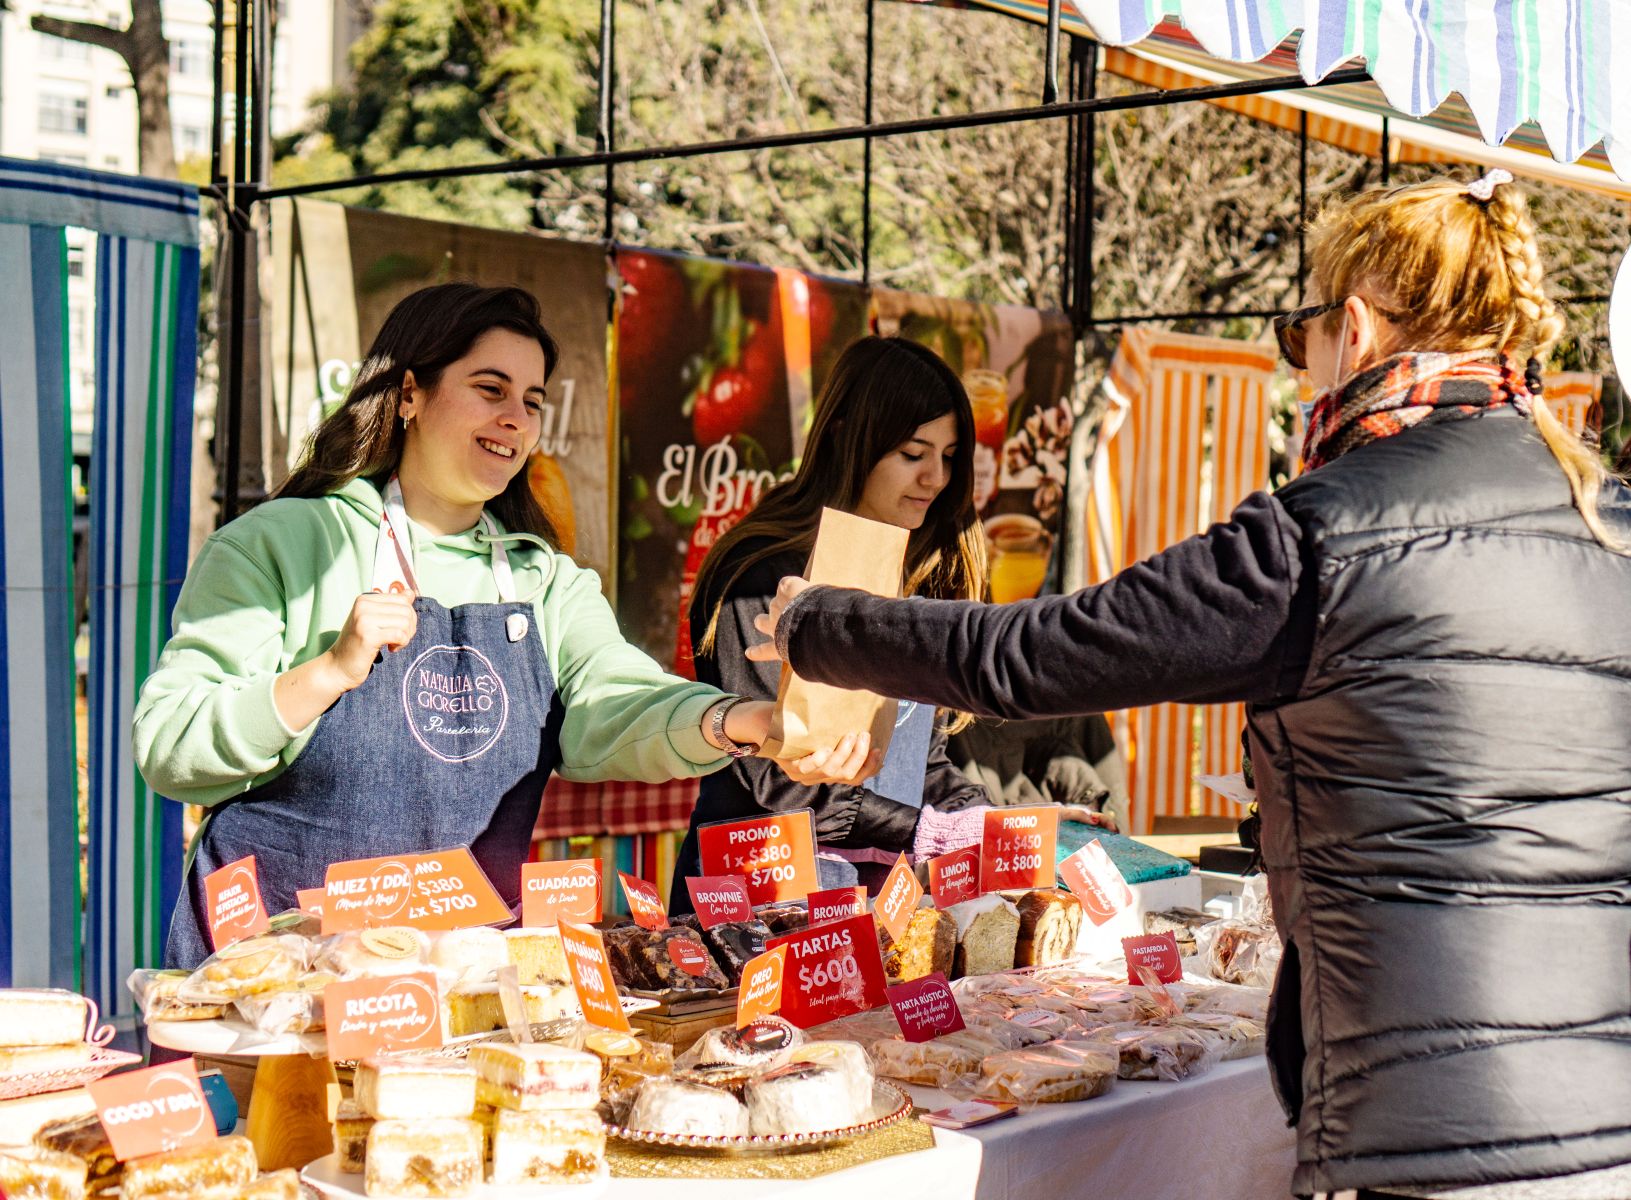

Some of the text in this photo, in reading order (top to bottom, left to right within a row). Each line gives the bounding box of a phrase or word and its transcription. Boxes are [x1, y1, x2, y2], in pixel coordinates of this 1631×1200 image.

[657, 444, 696, 508] El
[419, 669, 473, 694] NATALIA
[418, 691, 493, 712] GIORELLO
[1003, 815, 1038, 829] PROMO
[729, 825, 781, 845] PROMO
[996, 834, 1042, 853] 1 x $450
[723, 844, 791, 869] 1 x $380
[1012, 854, 1042, 873] $800
[327, 872, 411, 896] NUEZ Y DDL
[416, 876, 464, 896] $380
[527, 875, 597, 891] CUADRADO
[752, 865, 795, 887] $700
[696, 891, 743, 903] BROWNIE
[884, 871, 907, 914] CARROT
[429, 894, 478, 915] $700
[814, 903, 860, 920] BROWNIE
[790, 929, 852, 959] TARTAS
[751, 967, 773, 986] OREO
[799, 954, 858, 994] $600
[346, 992, 418, 1017] RICOTA
[896, 989, 949, 1012] TARTA RÚSTICA
[103, 1100, 154, 1125] COCO
[153, 1097, 166, 1115] Y
